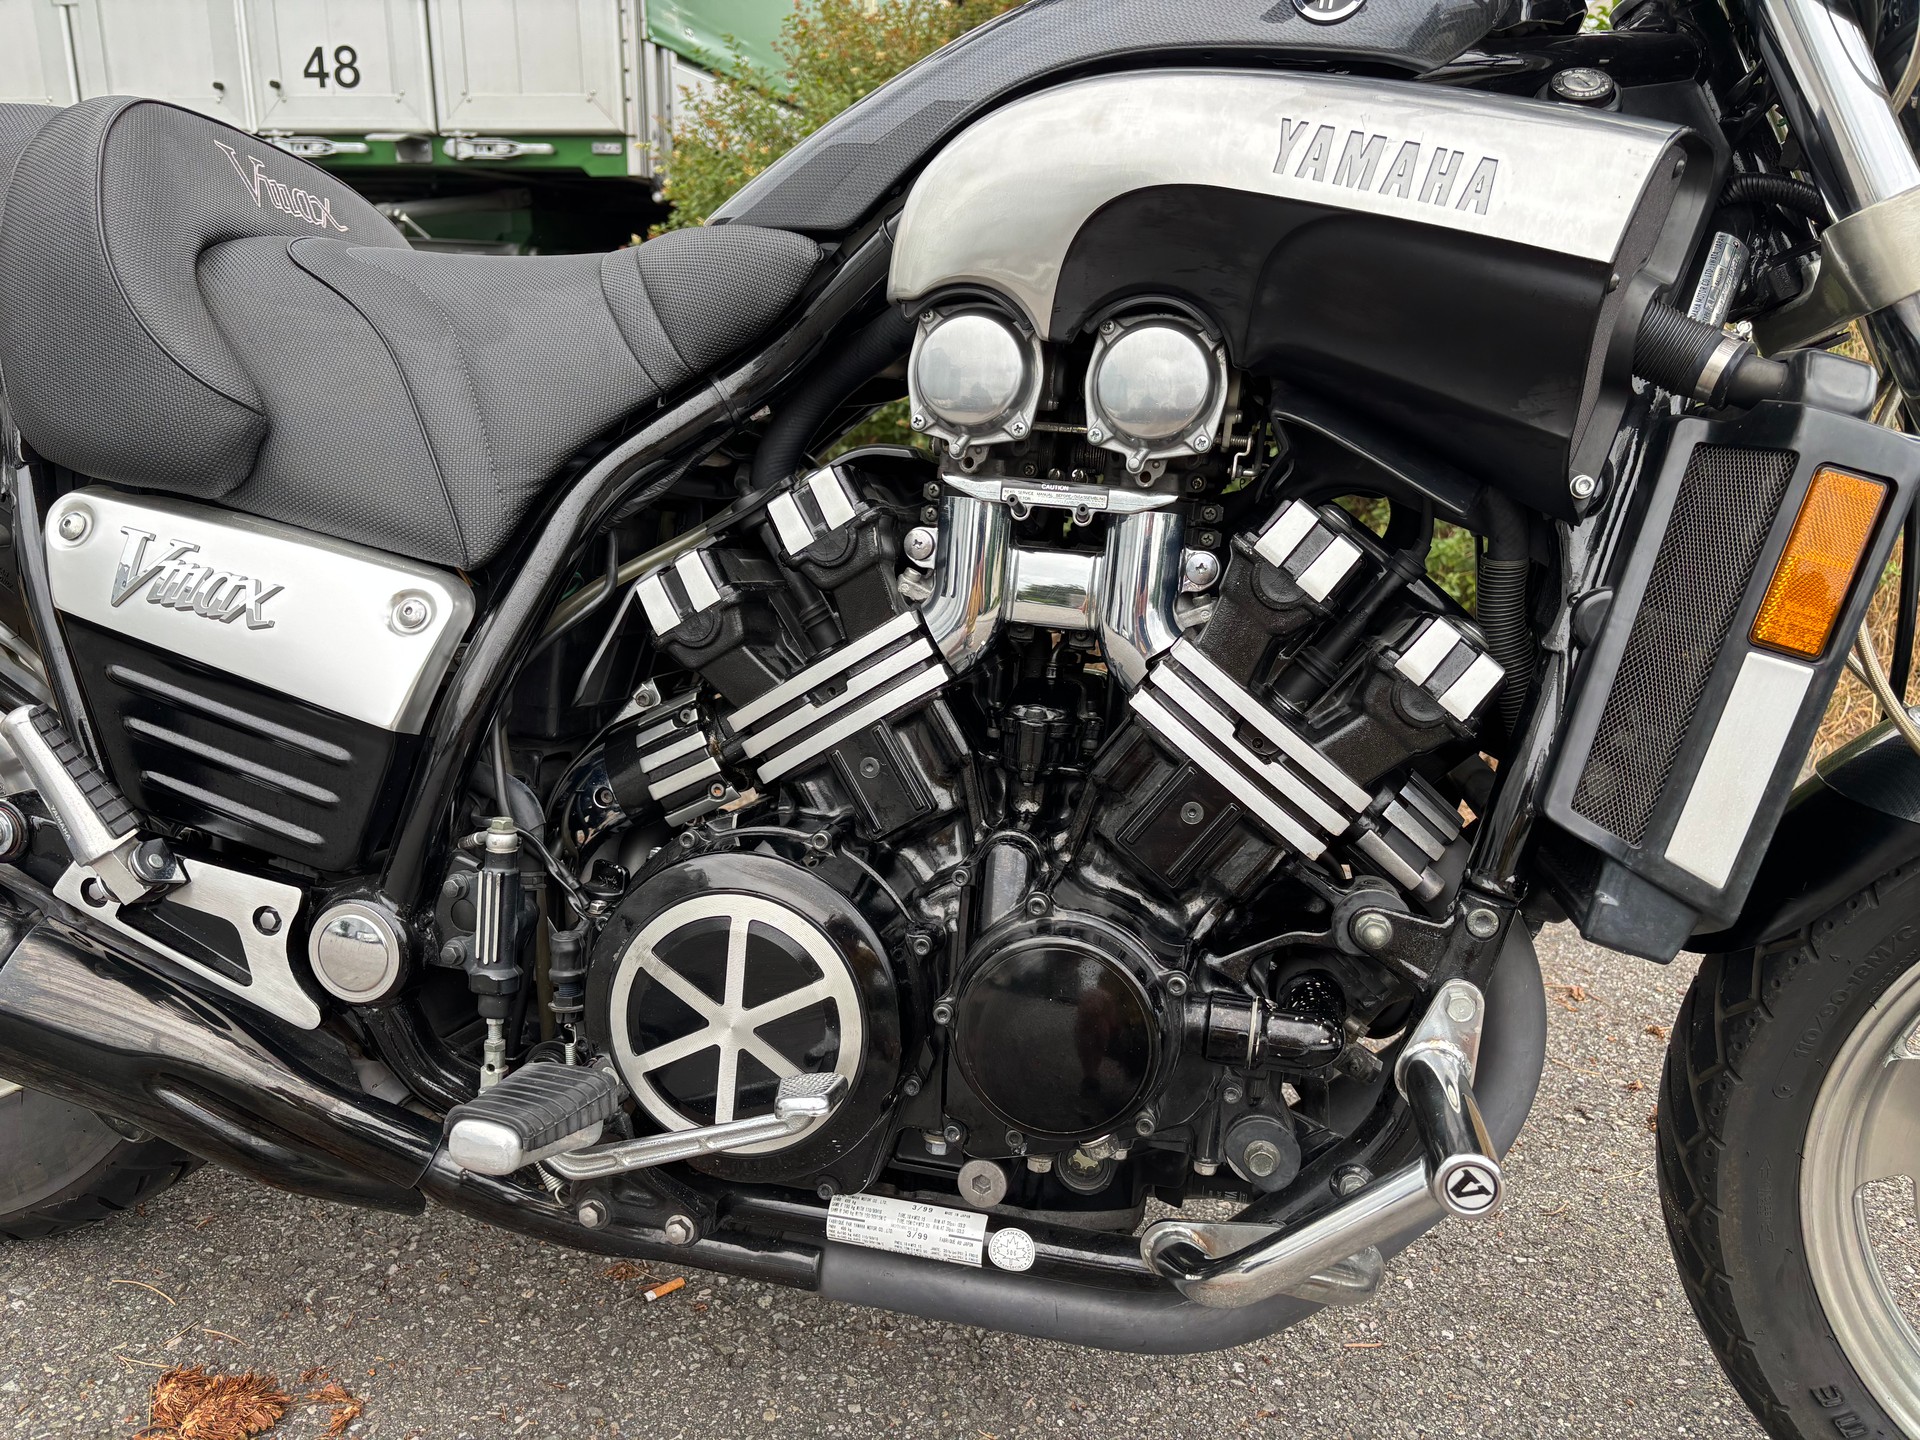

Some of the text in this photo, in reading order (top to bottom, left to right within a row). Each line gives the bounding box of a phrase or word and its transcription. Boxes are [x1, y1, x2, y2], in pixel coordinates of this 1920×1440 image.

[303, 46, 361, 89] 48
[213, 140, 348, 232] Vmax
[1272, 117, 1498, 215] YAMAHA
[110, 526, 284, 631] Vmax
[51, 804, 72, 841] YAMAHA
[911, 1204, 934, 1213] 3/99
[906, 1230, 928, 1241] 3/99
[1003, 1232, 1025, 1240] CANADA
